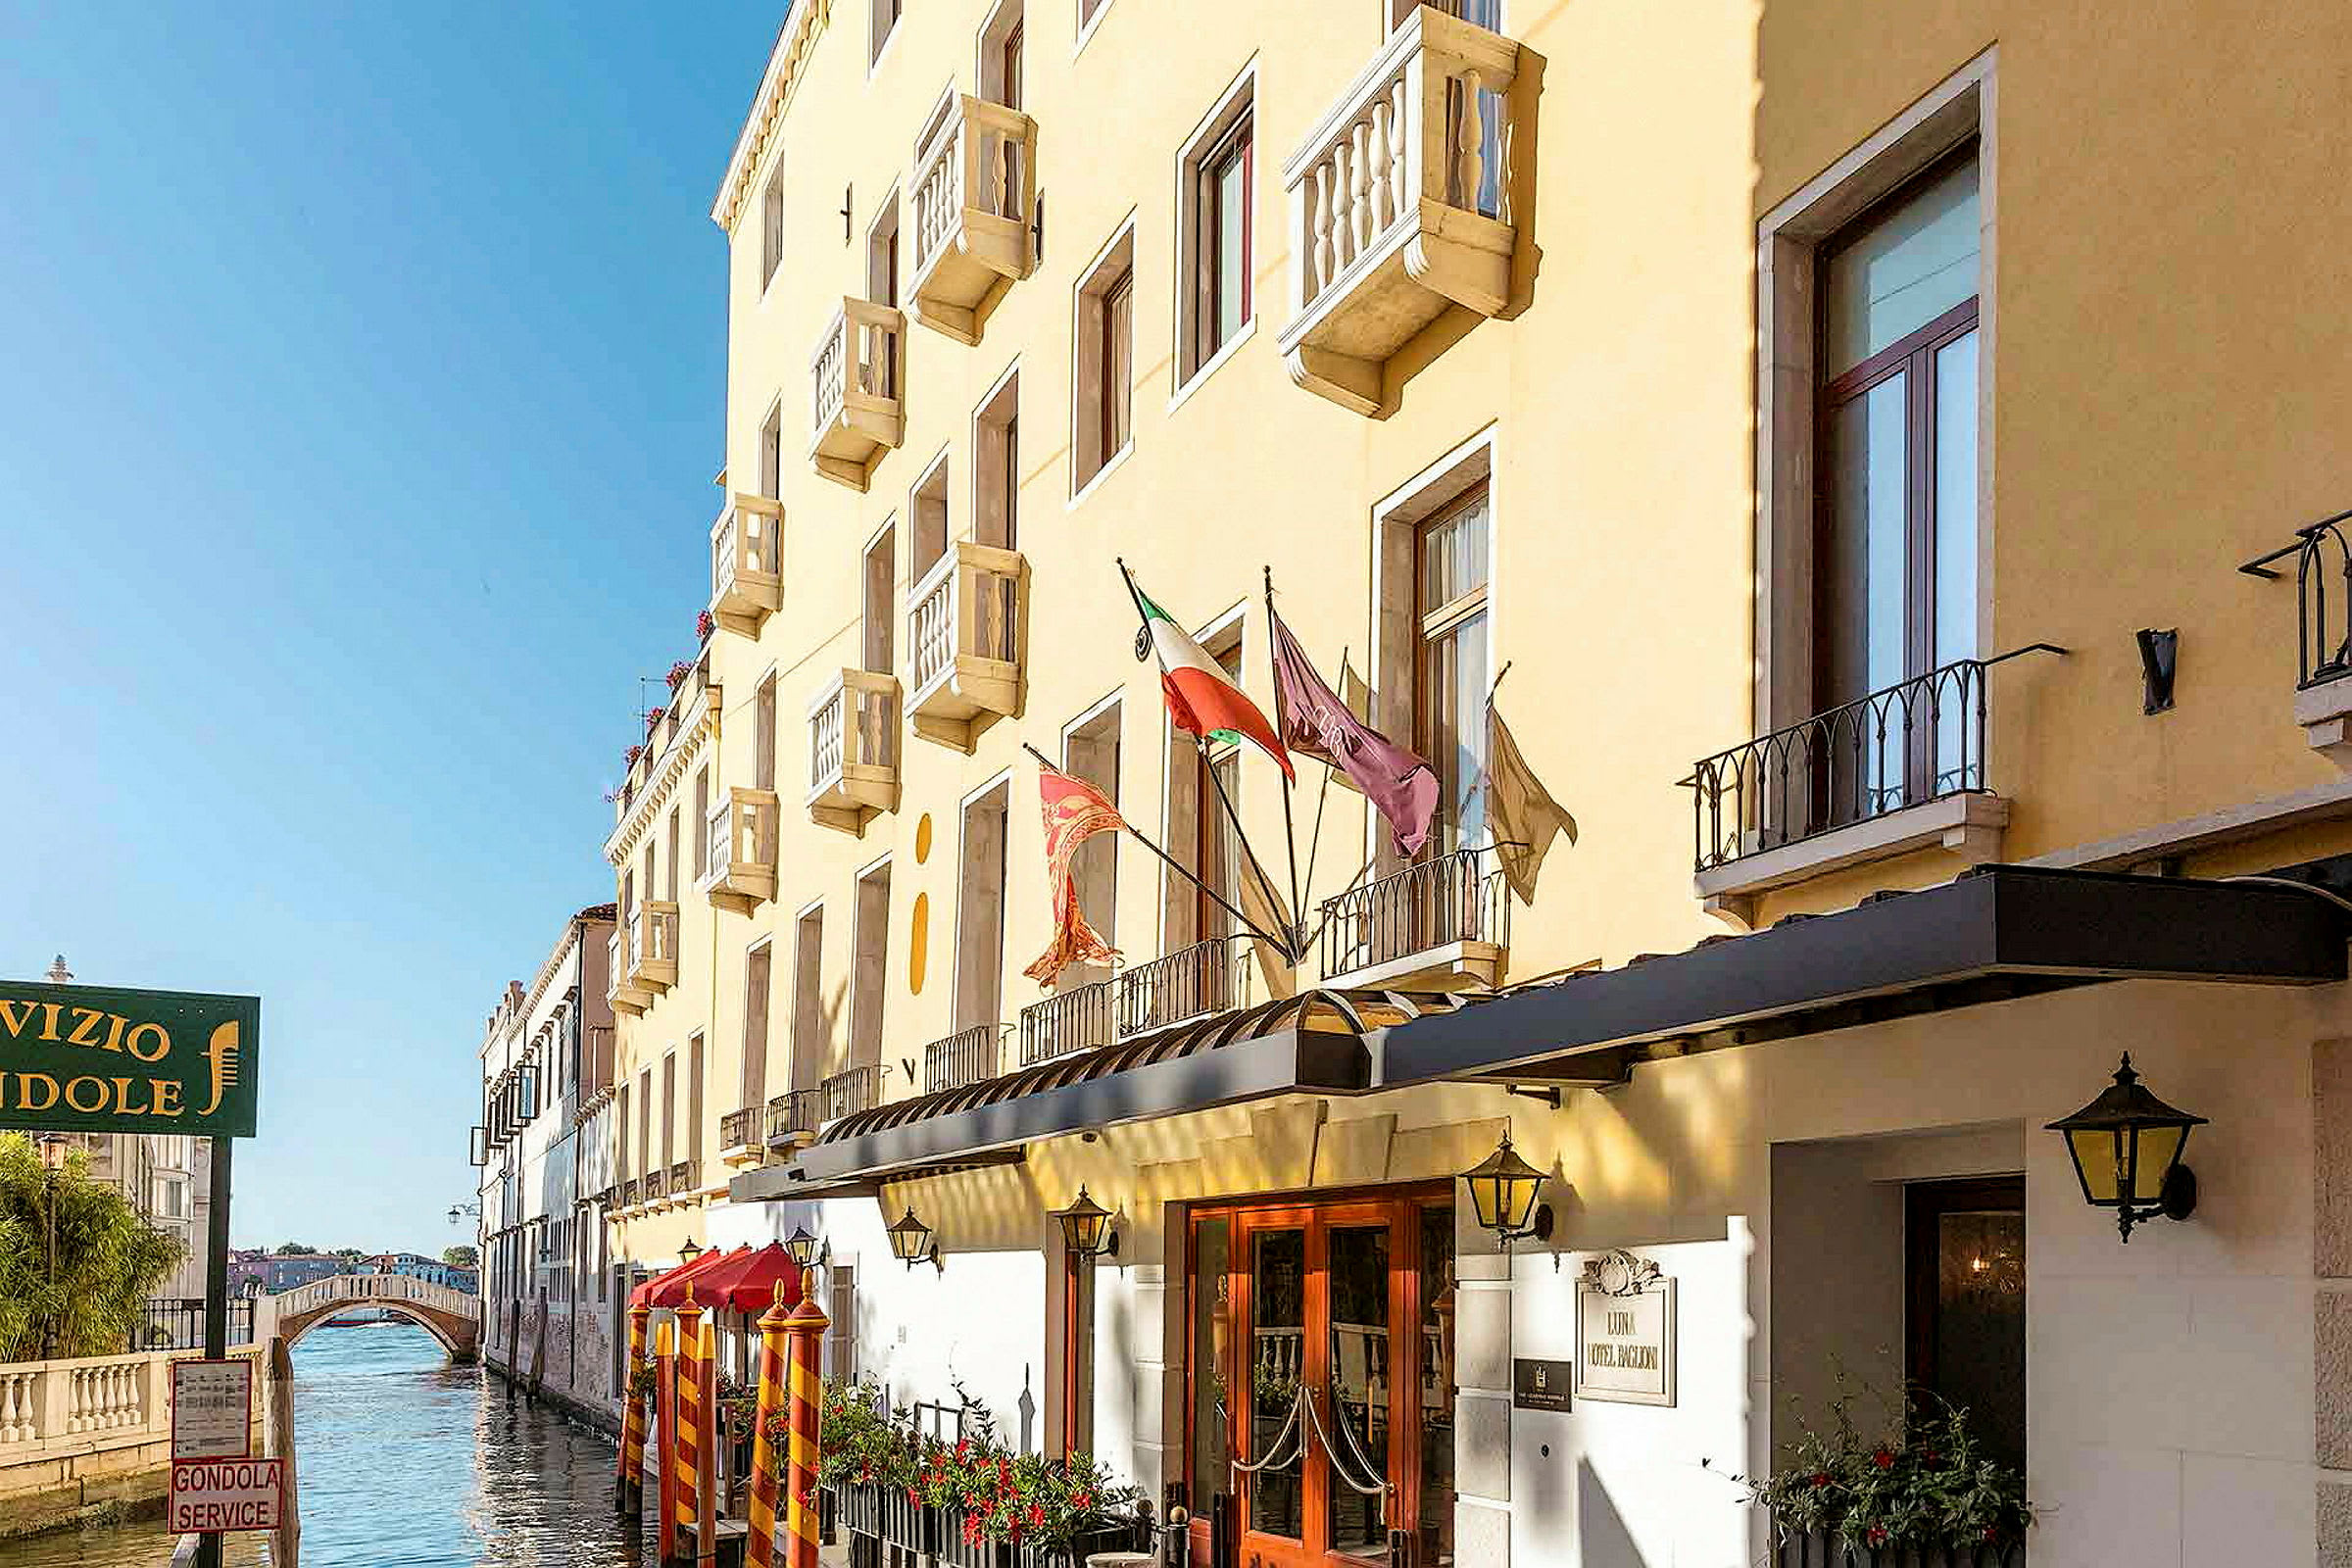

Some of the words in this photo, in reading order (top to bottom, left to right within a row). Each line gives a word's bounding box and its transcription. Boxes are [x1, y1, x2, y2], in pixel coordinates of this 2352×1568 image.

[0, 999, 172, 1062] VIZIO
[0, 1071, 185, 1117] DOLE
[1607, 1311, 1639, 1336] LUNA
[1588, 1343, 1616, 1368] HOTEL
[1617, 1345, 1658, 1370] BAGLIONI
[174, 1464, 279, 1492] GONDOLA
[178, 1500, 270, 1529] SERVICE
